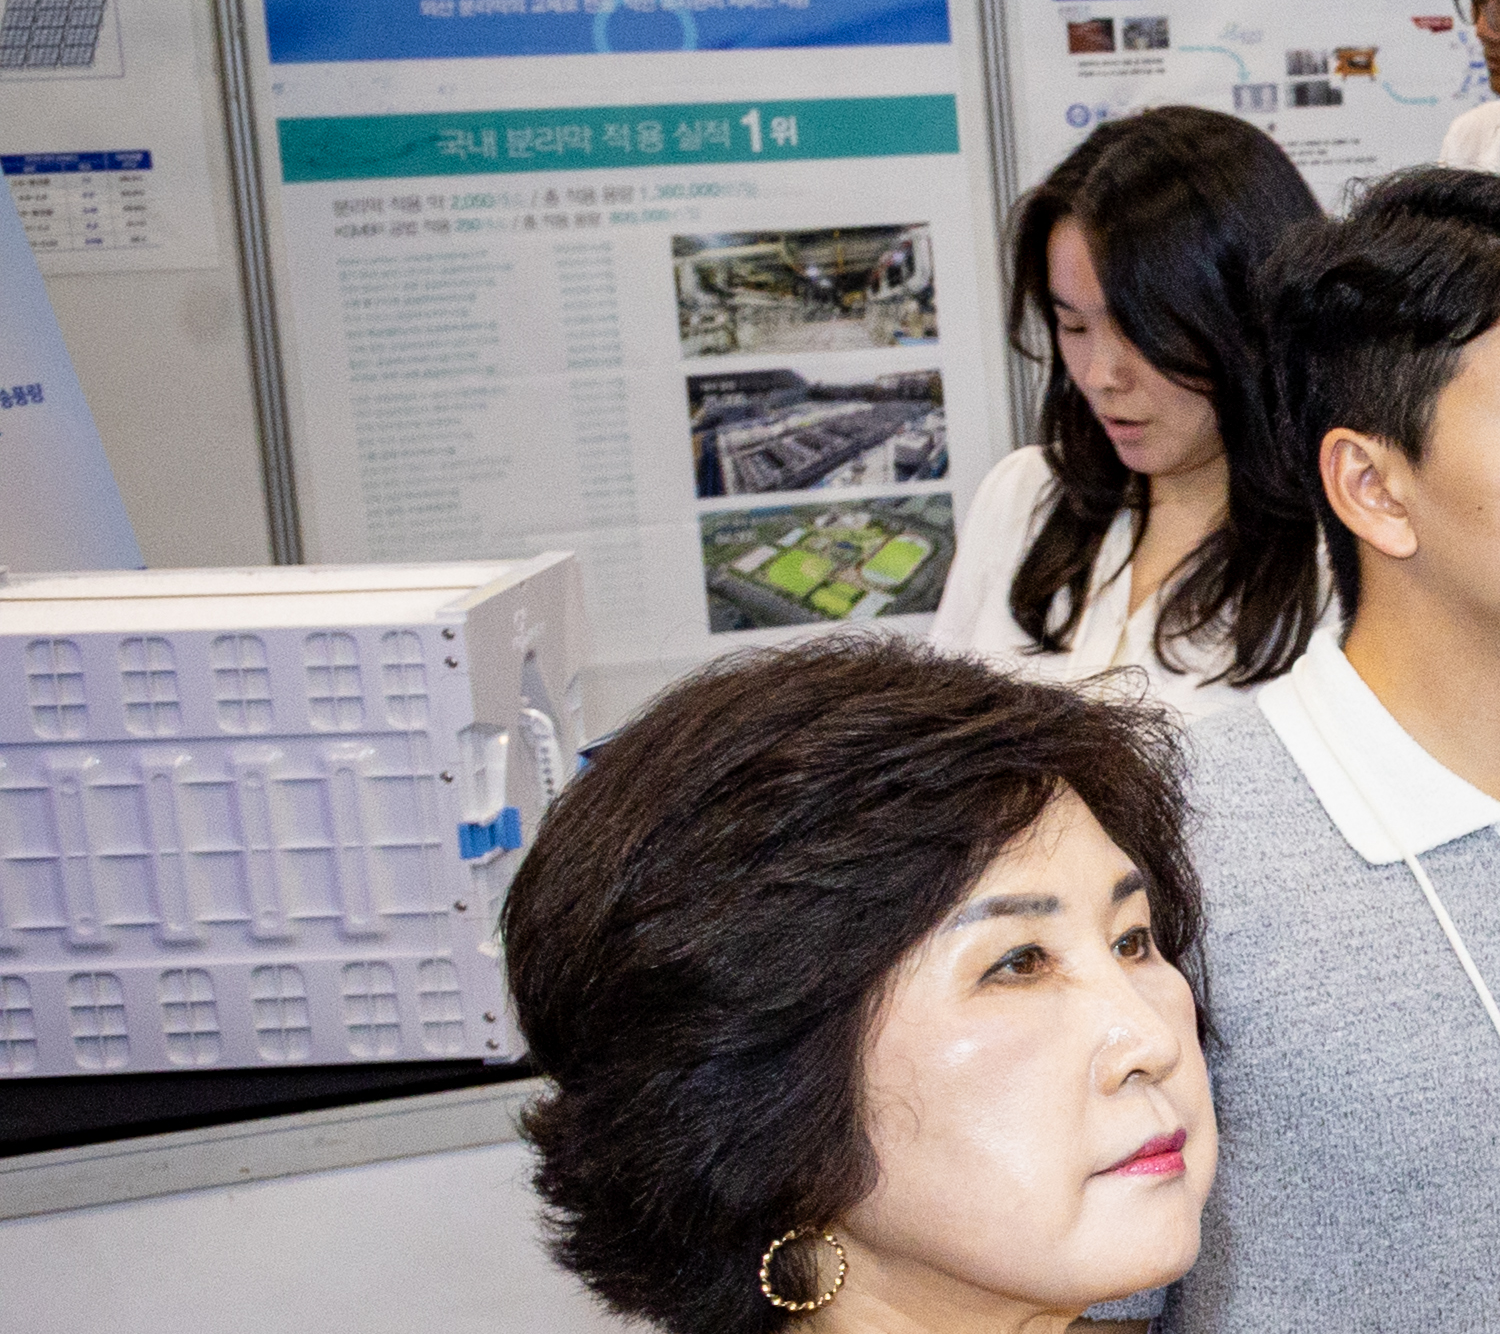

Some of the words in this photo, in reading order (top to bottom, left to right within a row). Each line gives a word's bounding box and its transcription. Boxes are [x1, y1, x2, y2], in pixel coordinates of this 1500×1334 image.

[438, 129, 496, 159] 국내
[506, 125, 593, 158] 분리막
[604, 121, 665, 153] 적용
[673, 119, 731, 152] 실적
[740, 108, 798, 152] 1위
